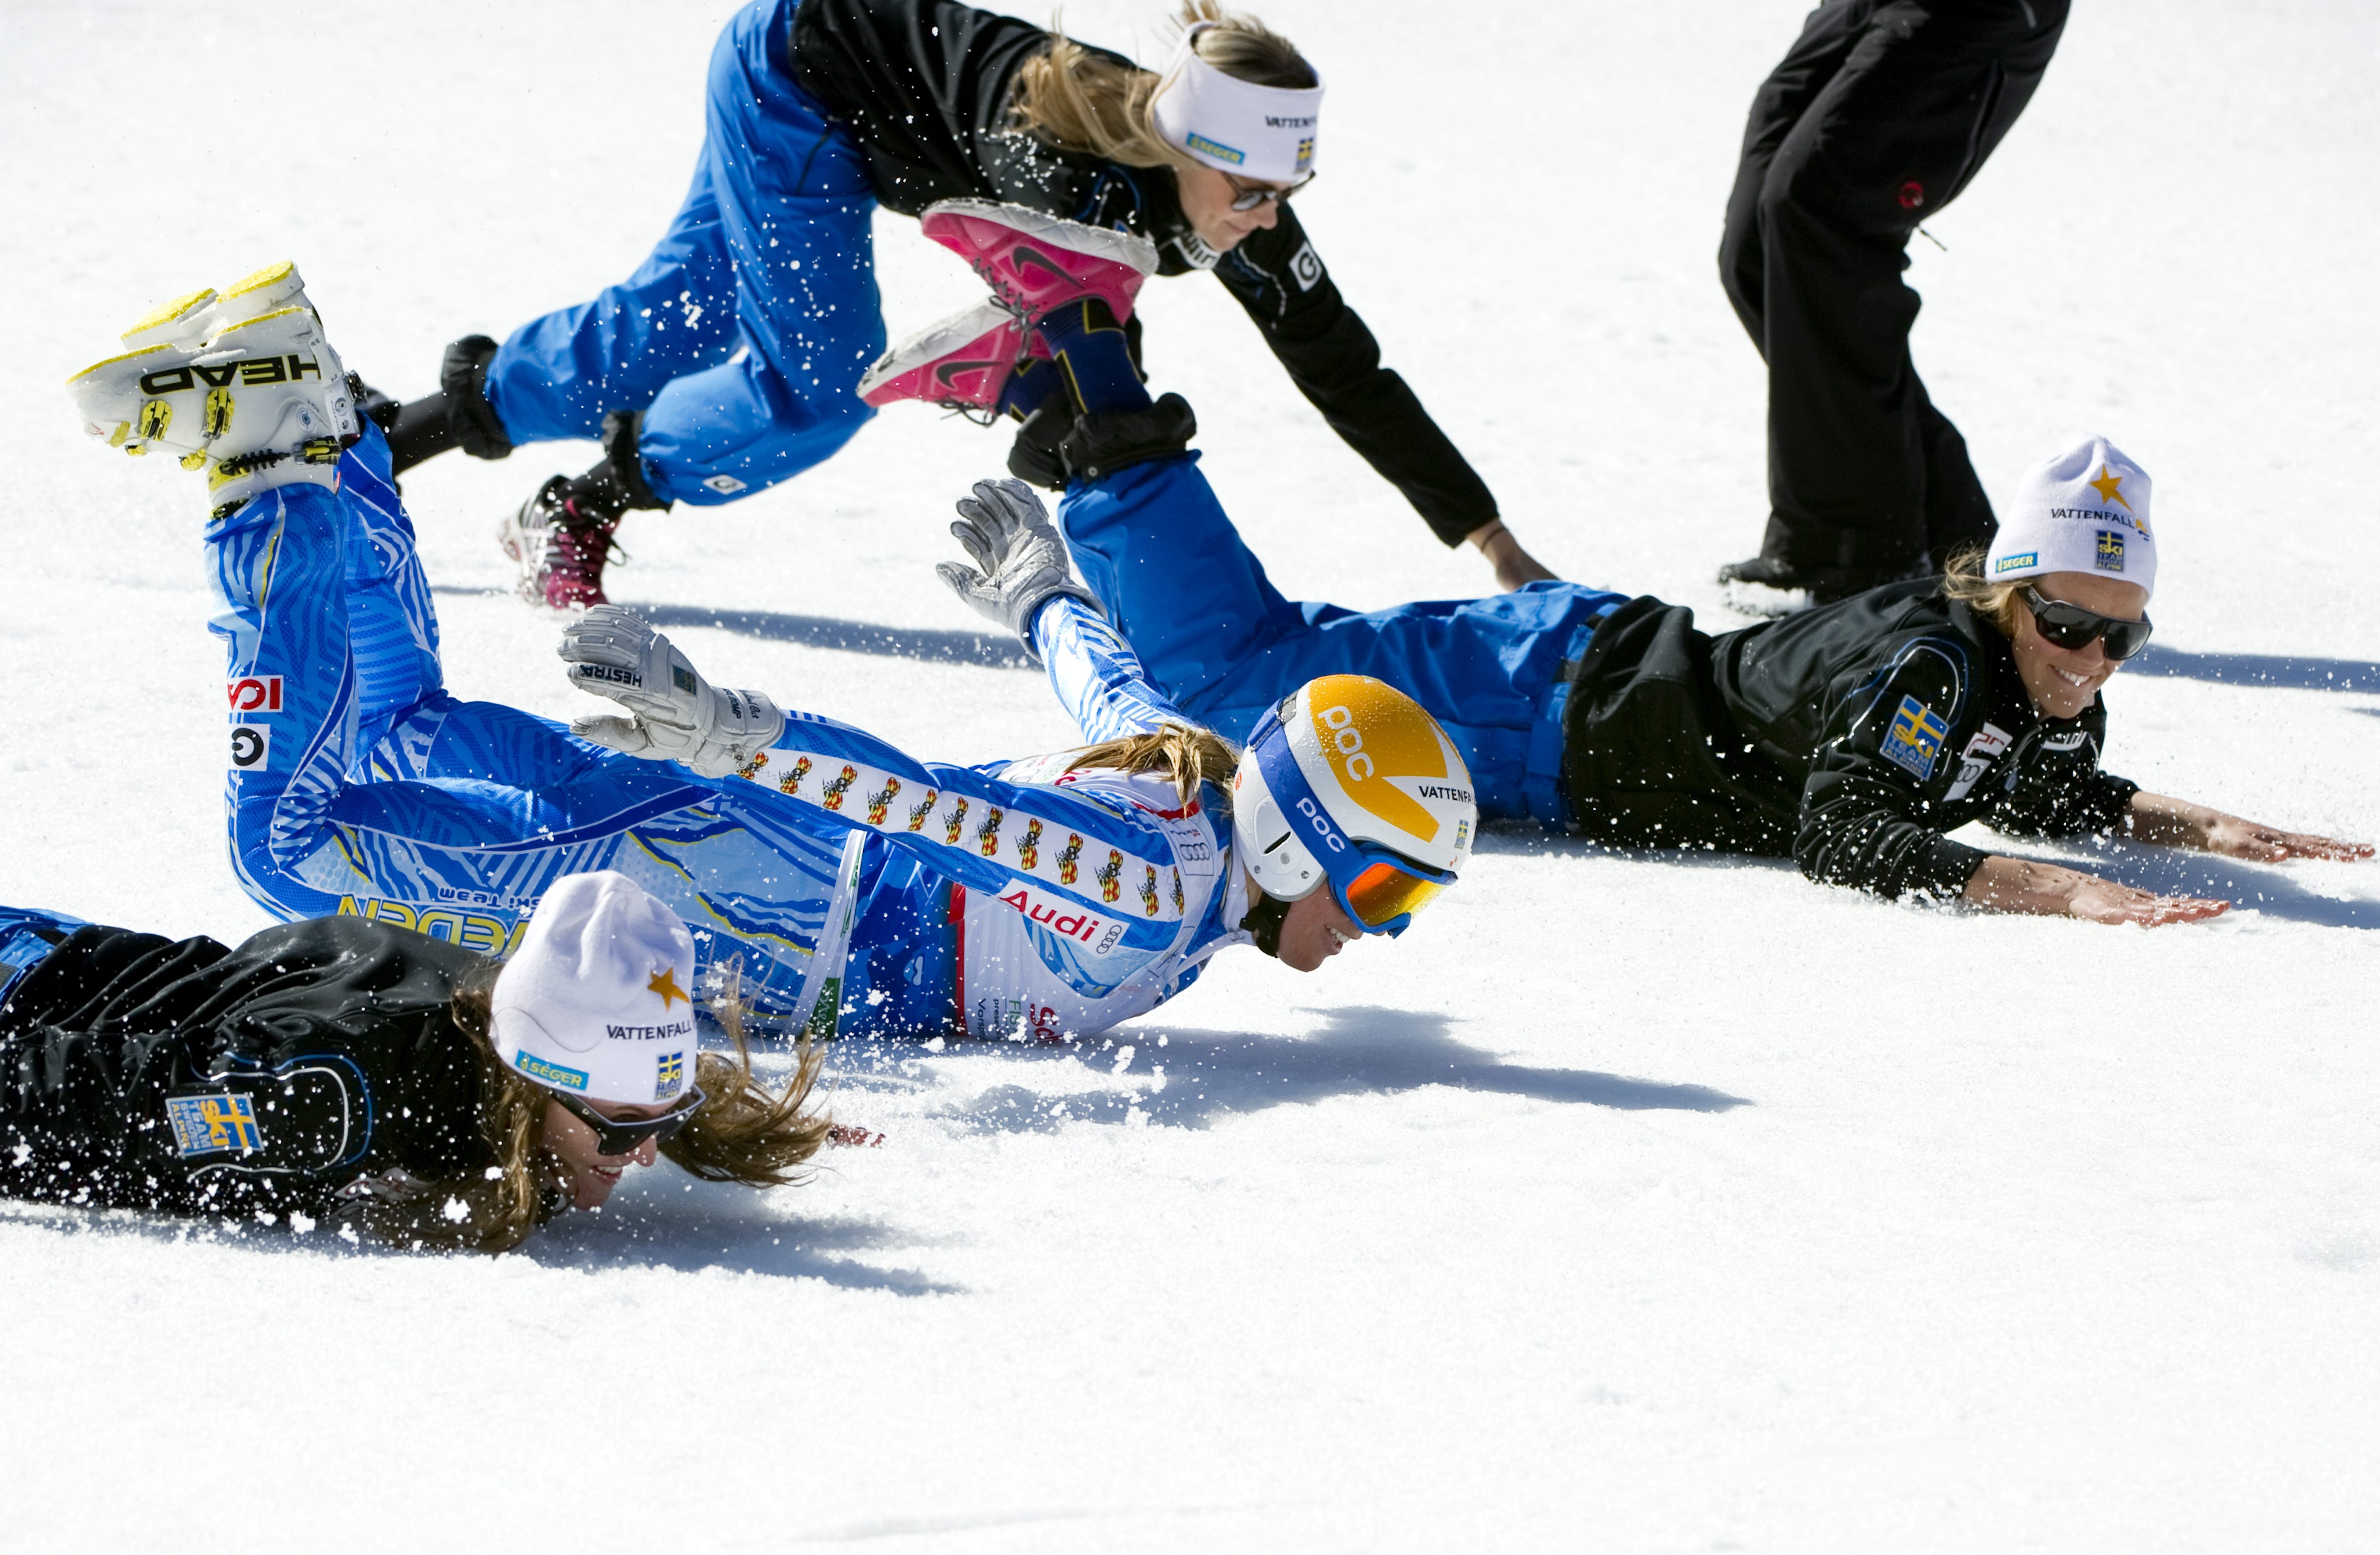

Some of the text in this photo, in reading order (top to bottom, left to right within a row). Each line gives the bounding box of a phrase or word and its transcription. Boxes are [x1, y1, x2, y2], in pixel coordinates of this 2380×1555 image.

[138, 353, 322, 396] HEAD
[2051, 508, 2135, 529] VATTENFALL
[2003, 556, 2034, 569] SEGER
[580, 664, 642, 688] HESTRA
[1892, 735, 1930, 765] TEAM
[439, 888, 501, 907] Team
[999, 890, 1099, 942] Audi
[607, 1020, 692, 1040] VATTENFALL
[529, 1062, 582, 1086] SEGER
[171, 1103, 192, 1148] ALPINE
[180, 1102, 201, 1149] SWEDEN
[189, 1101, 212, 1148] TEAM
[200, 1100, 230, 1147] SKI
